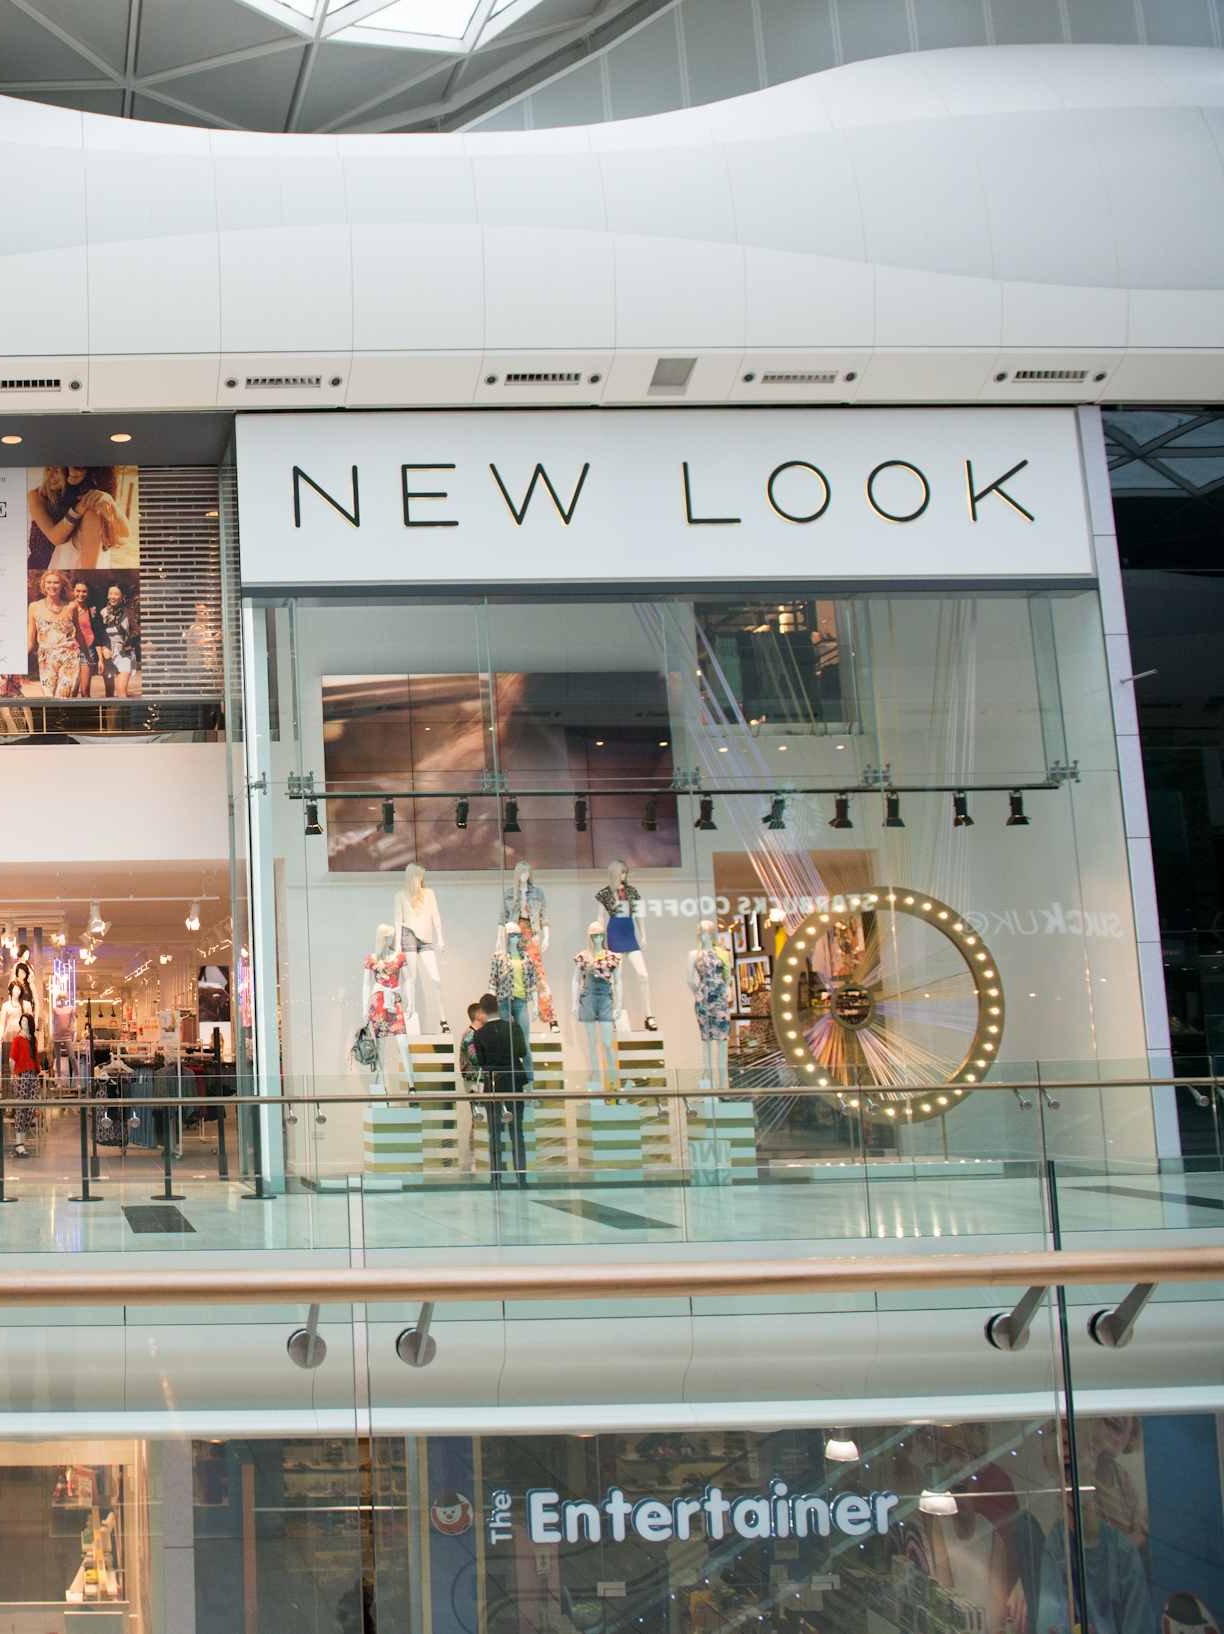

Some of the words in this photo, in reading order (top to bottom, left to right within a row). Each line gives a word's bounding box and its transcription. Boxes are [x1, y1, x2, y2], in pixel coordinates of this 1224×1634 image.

[294, 463, 590, 528] NEW
[683, 460, 1036, 524] LOOK
[488, 1489, 513, 1545] The
[528, 1479, 900, 1543] Entertainer
